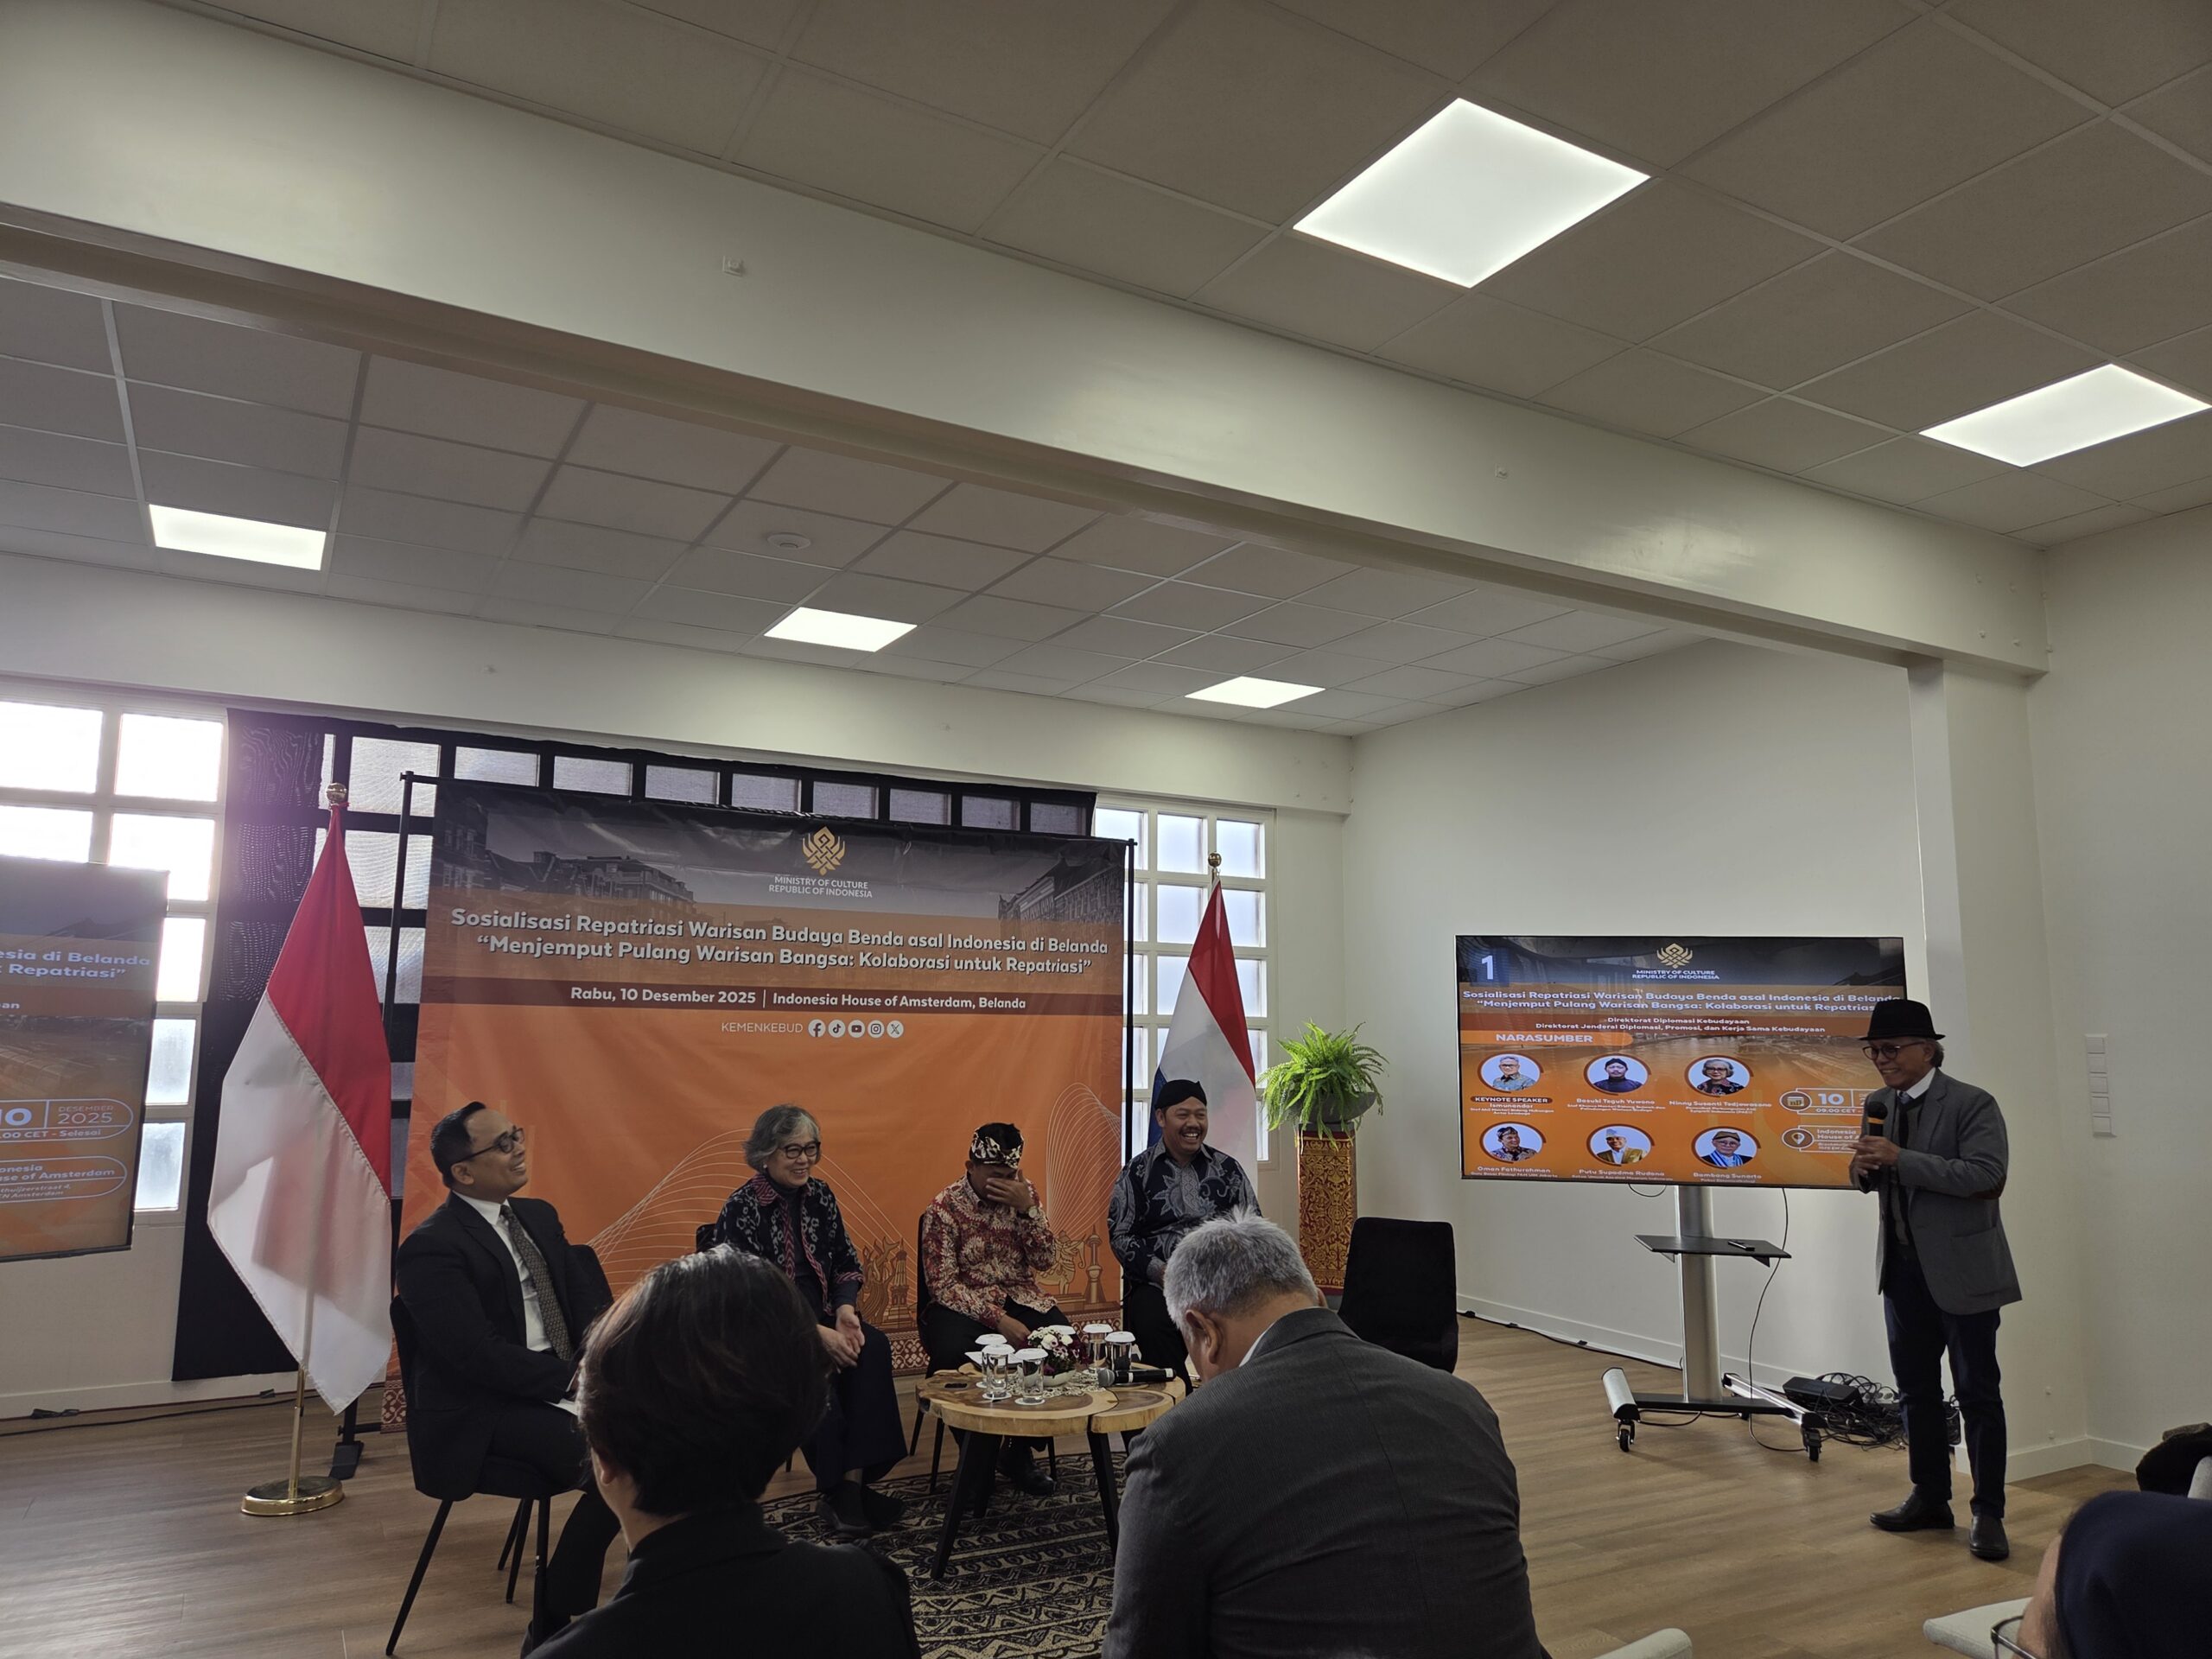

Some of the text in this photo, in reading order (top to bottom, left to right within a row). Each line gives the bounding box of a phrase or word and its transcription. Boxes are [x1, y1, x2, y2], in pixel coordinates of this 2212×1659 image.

[774, 875, 868, 889] MINISTRY OF CULTURE
[769, 884, 873, 898] REPUBLIC OF INDONESIA
[451, 908, 1109, 955] Sosialisasi Repatriasi Warisan Budaya Benda asal Indonesia di Belanda
[42, 950, 61, 961] di
[68, 953, 150, 966] Belanda
[478, 935, 1092, 976] “Menjemput Pulang Warisan Bangsa: Kolaborasi untuk Repatriasi”
[9, 963, 126, 978] Repatriasi”
[1481, 955, 1494, 980] 1
[570, 987, 1027, 1010] Rabu, 10 Desember 2025 Indonesia House of Amsterdam, Belanda
[1462, 991, 1526, 999] Sosialisasi
[1529, 991, 1590, 1000] Repatriasi
[1646, 992, 1694, 1001] Budaya
[1477, 1000, 1875, 1012] “Menjemput Pulang Warisan Bangsa: Kolaborasi untuk Repatrias
[721, 1021, 803, 1033] KEMENKEBUD
[1496, 1034, 1593, 1043] NARASUMBER
[1818, 1093, 1844, 1105] 10
[57, 1112, 112, 1124] 2025
[39, 1170, 115, 1180] Amsterdam
